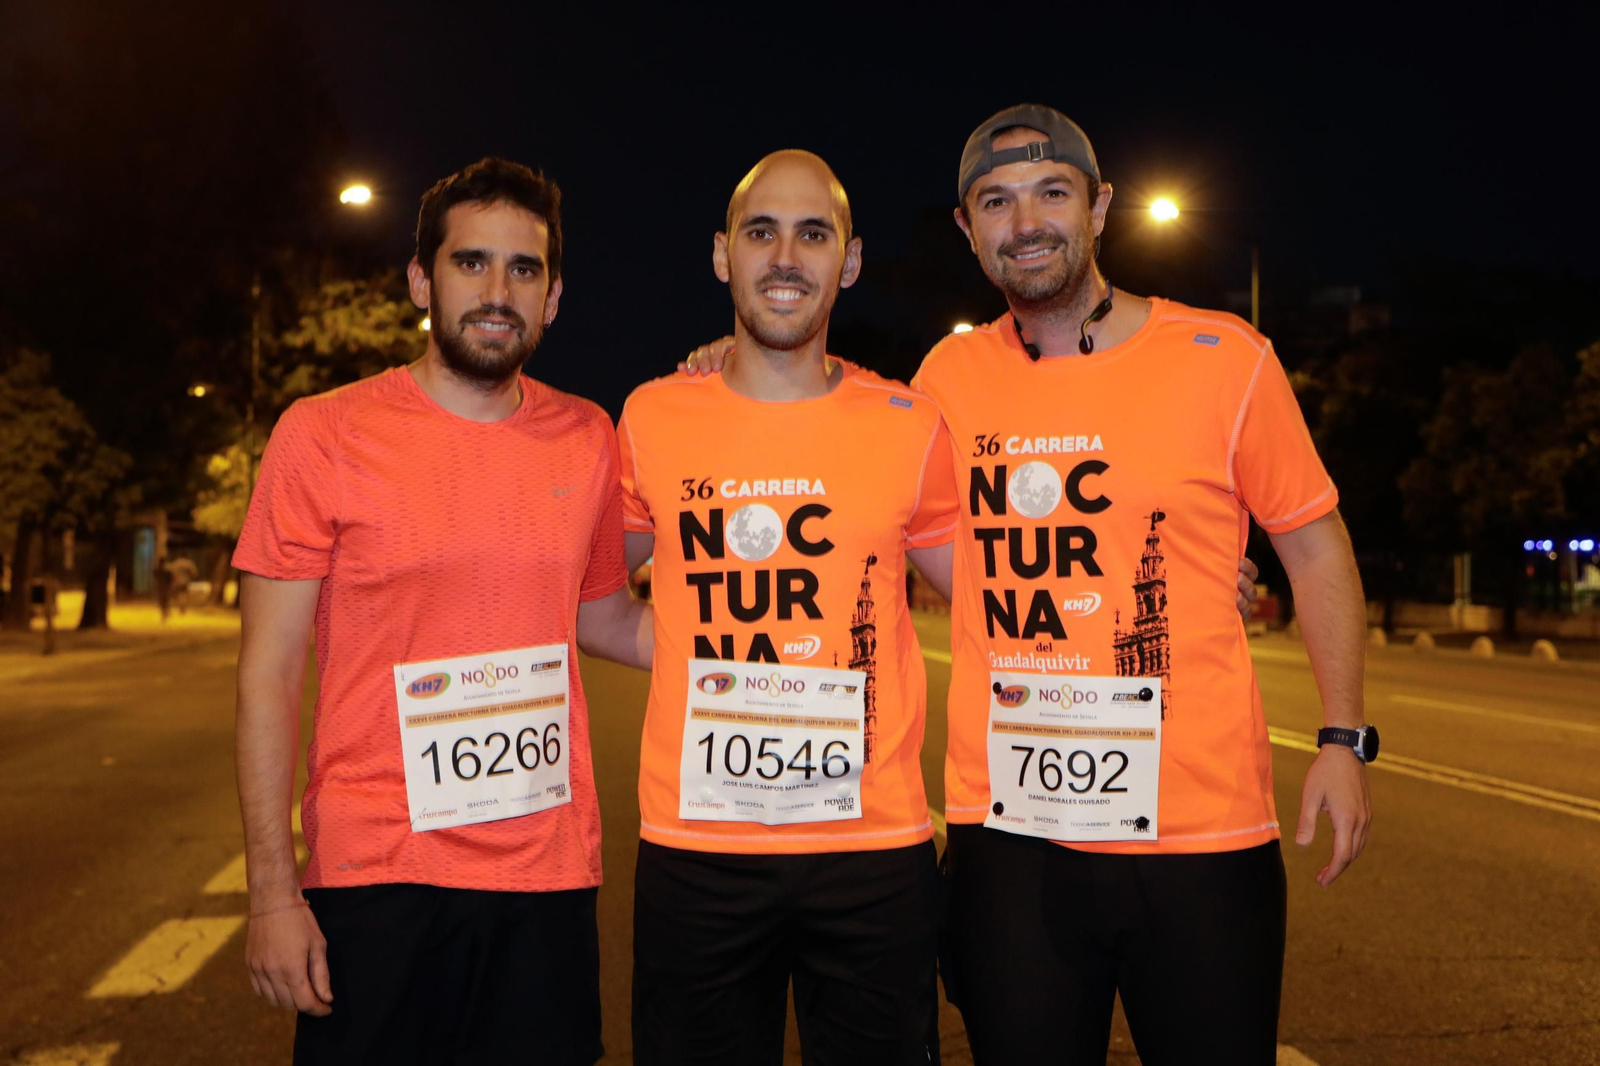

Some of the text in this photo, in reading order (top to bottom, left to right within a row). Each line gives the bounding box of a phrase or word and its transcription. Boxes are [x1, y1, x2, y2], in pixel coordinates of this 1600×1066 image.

[973, 433, 1104, 457] 36 CARRERA
[681, 477, 826, 501] 36 CARRERA
[974, 526, 1104, 580] TUR
[686, 568, 824, 624] TUR
[983, 589, 1068, 640] NA
[1036, 642, 1053, 653] del
[989, 652, 1090, 673] Guadalquivir
[429, 713, 457, 722] CARRERA
[458, 708, 489, 717] NOCTURNA
[490, 706, 501, 714] DEL
[711, 711, 736, 719] CARRERA
[737, 714, 768, 722] NOCTURNA
[781, 718, 826, 727] GUADALQUIVIR
[1033, 726, 1061, 734] NOCTURNA
[421, 722, 561, 785] 16266
[699, 732, 850, 780] 10546
[1011, 745, 1129, 793] 7692
[722, 780, 819, 792] JOSE LUIS CAMPOS MARTINEZ
[824, 797, 854, 807] POWER
[1028, 794, 1047, 802] DANIEL
[1048, 797, 1077, 805] MORALES
